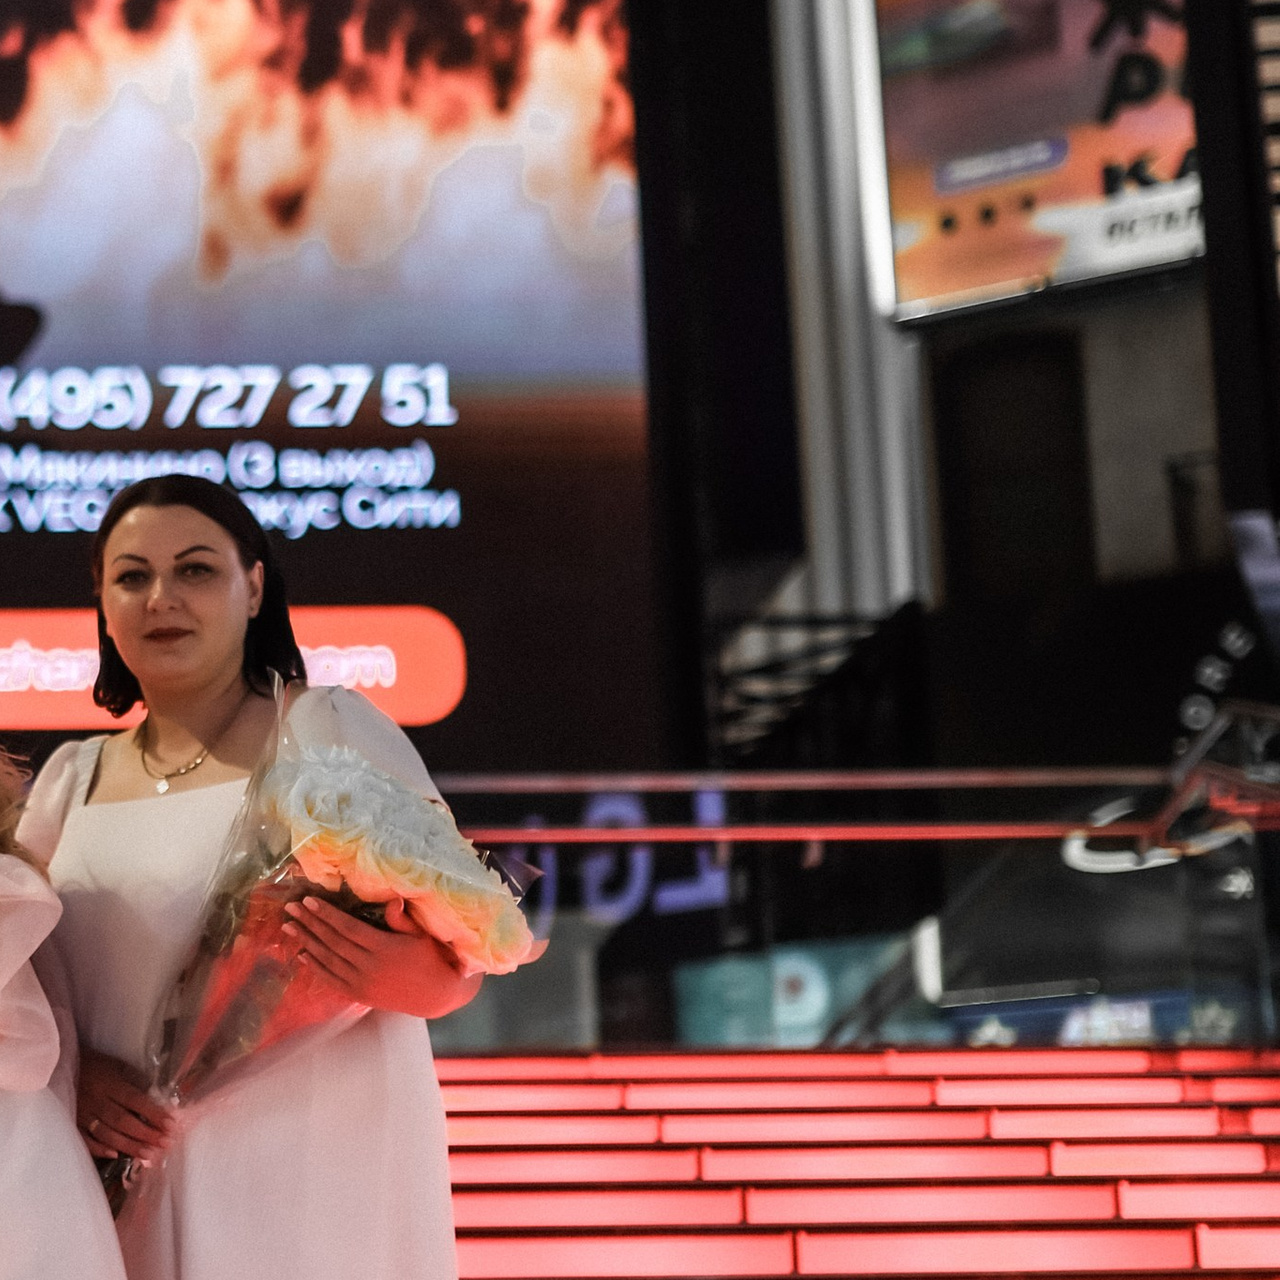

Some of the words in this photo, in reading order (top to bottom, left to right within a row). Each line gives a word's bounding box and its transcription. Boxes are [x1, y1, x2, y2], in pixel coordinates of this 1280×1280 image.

[157, 364, 283, 429] 727
[287, 364, 375, 428] 27
[380, 363, 459, 427] 51
